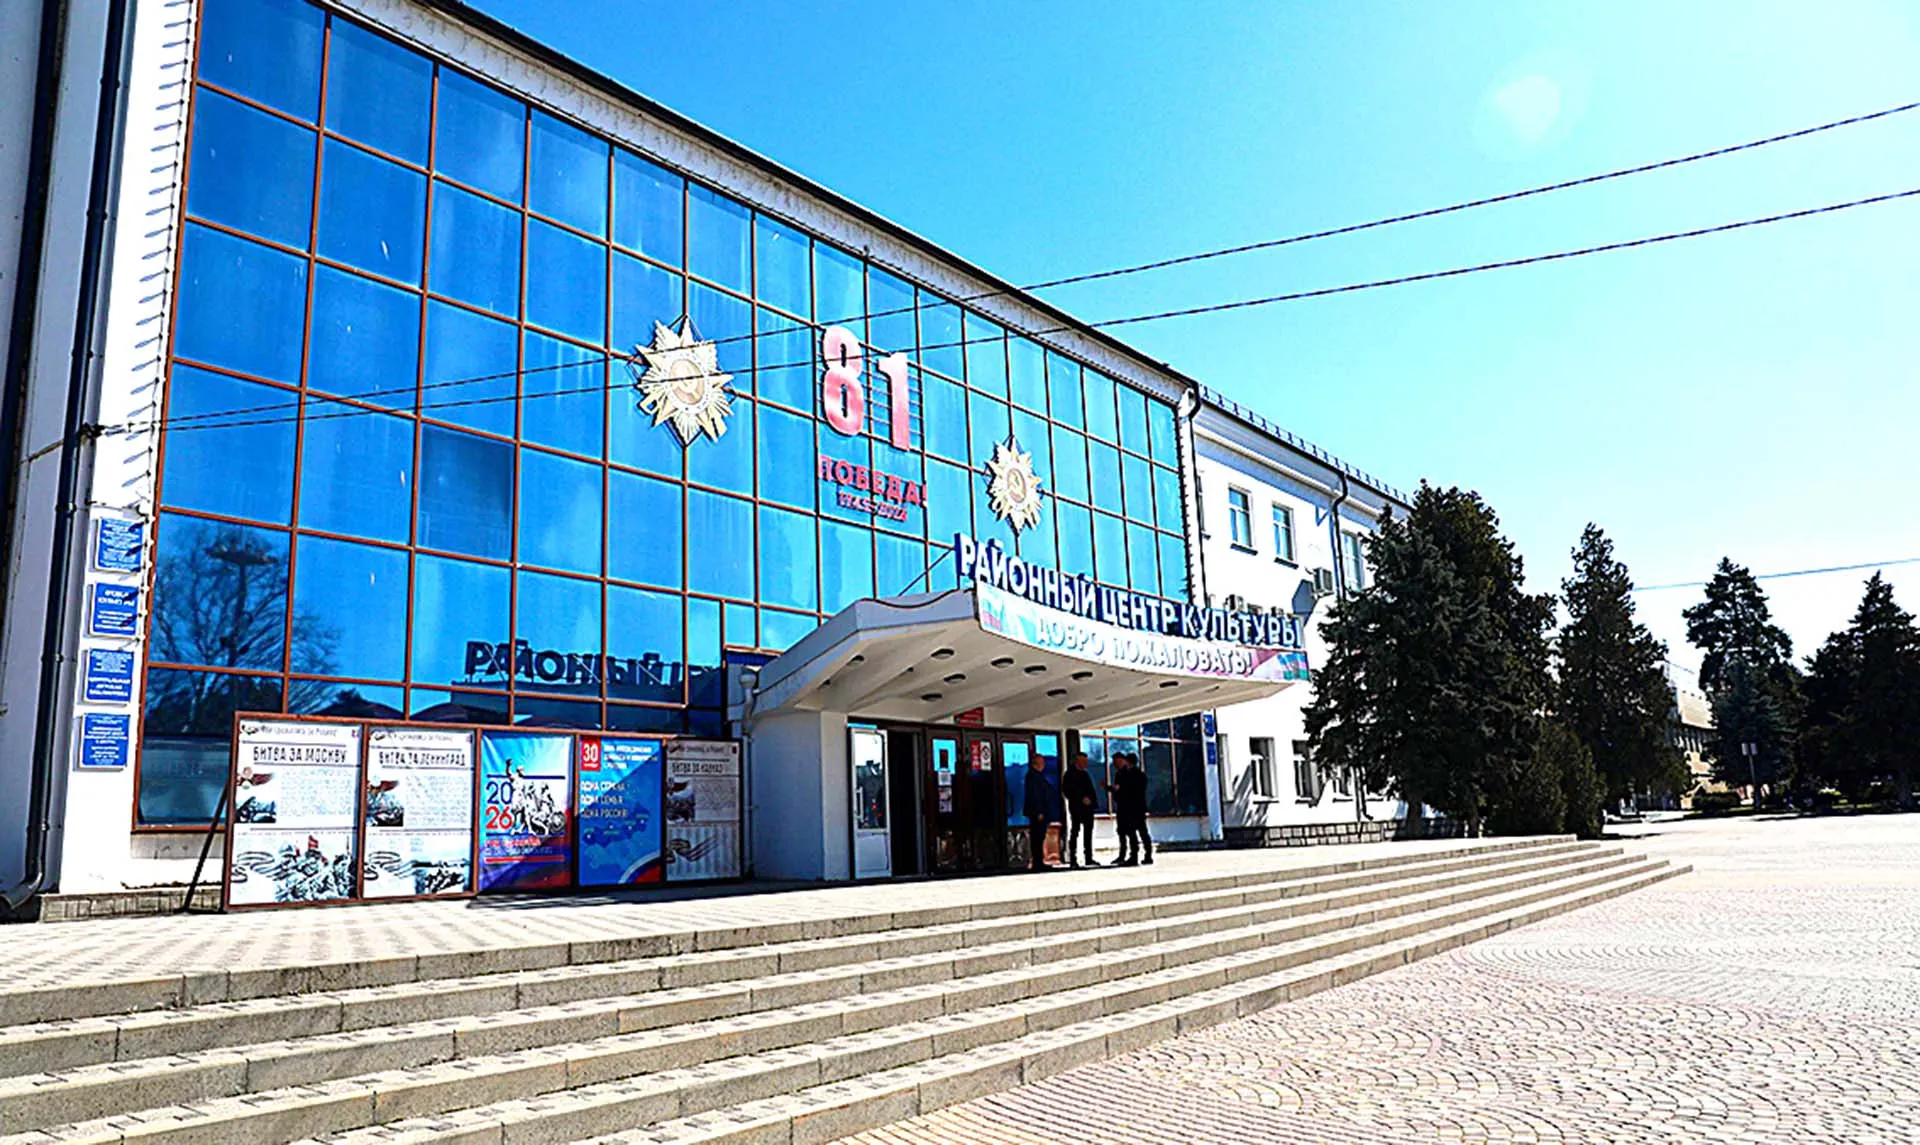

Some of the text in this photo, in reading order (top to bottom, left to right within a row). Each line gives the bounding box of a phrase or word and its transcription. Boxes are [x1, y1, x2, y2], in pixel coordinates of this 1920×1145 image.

[823, 325, 911, 451] 81
[818, 453, 928, 508] ПОБЕДА!
[955, 532, 1302, 650] РАЙОННЫЙ ЦЕНТР КУЛЬТУРЫ
[1038, 617, 1105, 657] ДОБРО
[583, 743, 599, 762] 30
[486, 781, 514, 805] 20
[485, 806, 513, 830] 26
